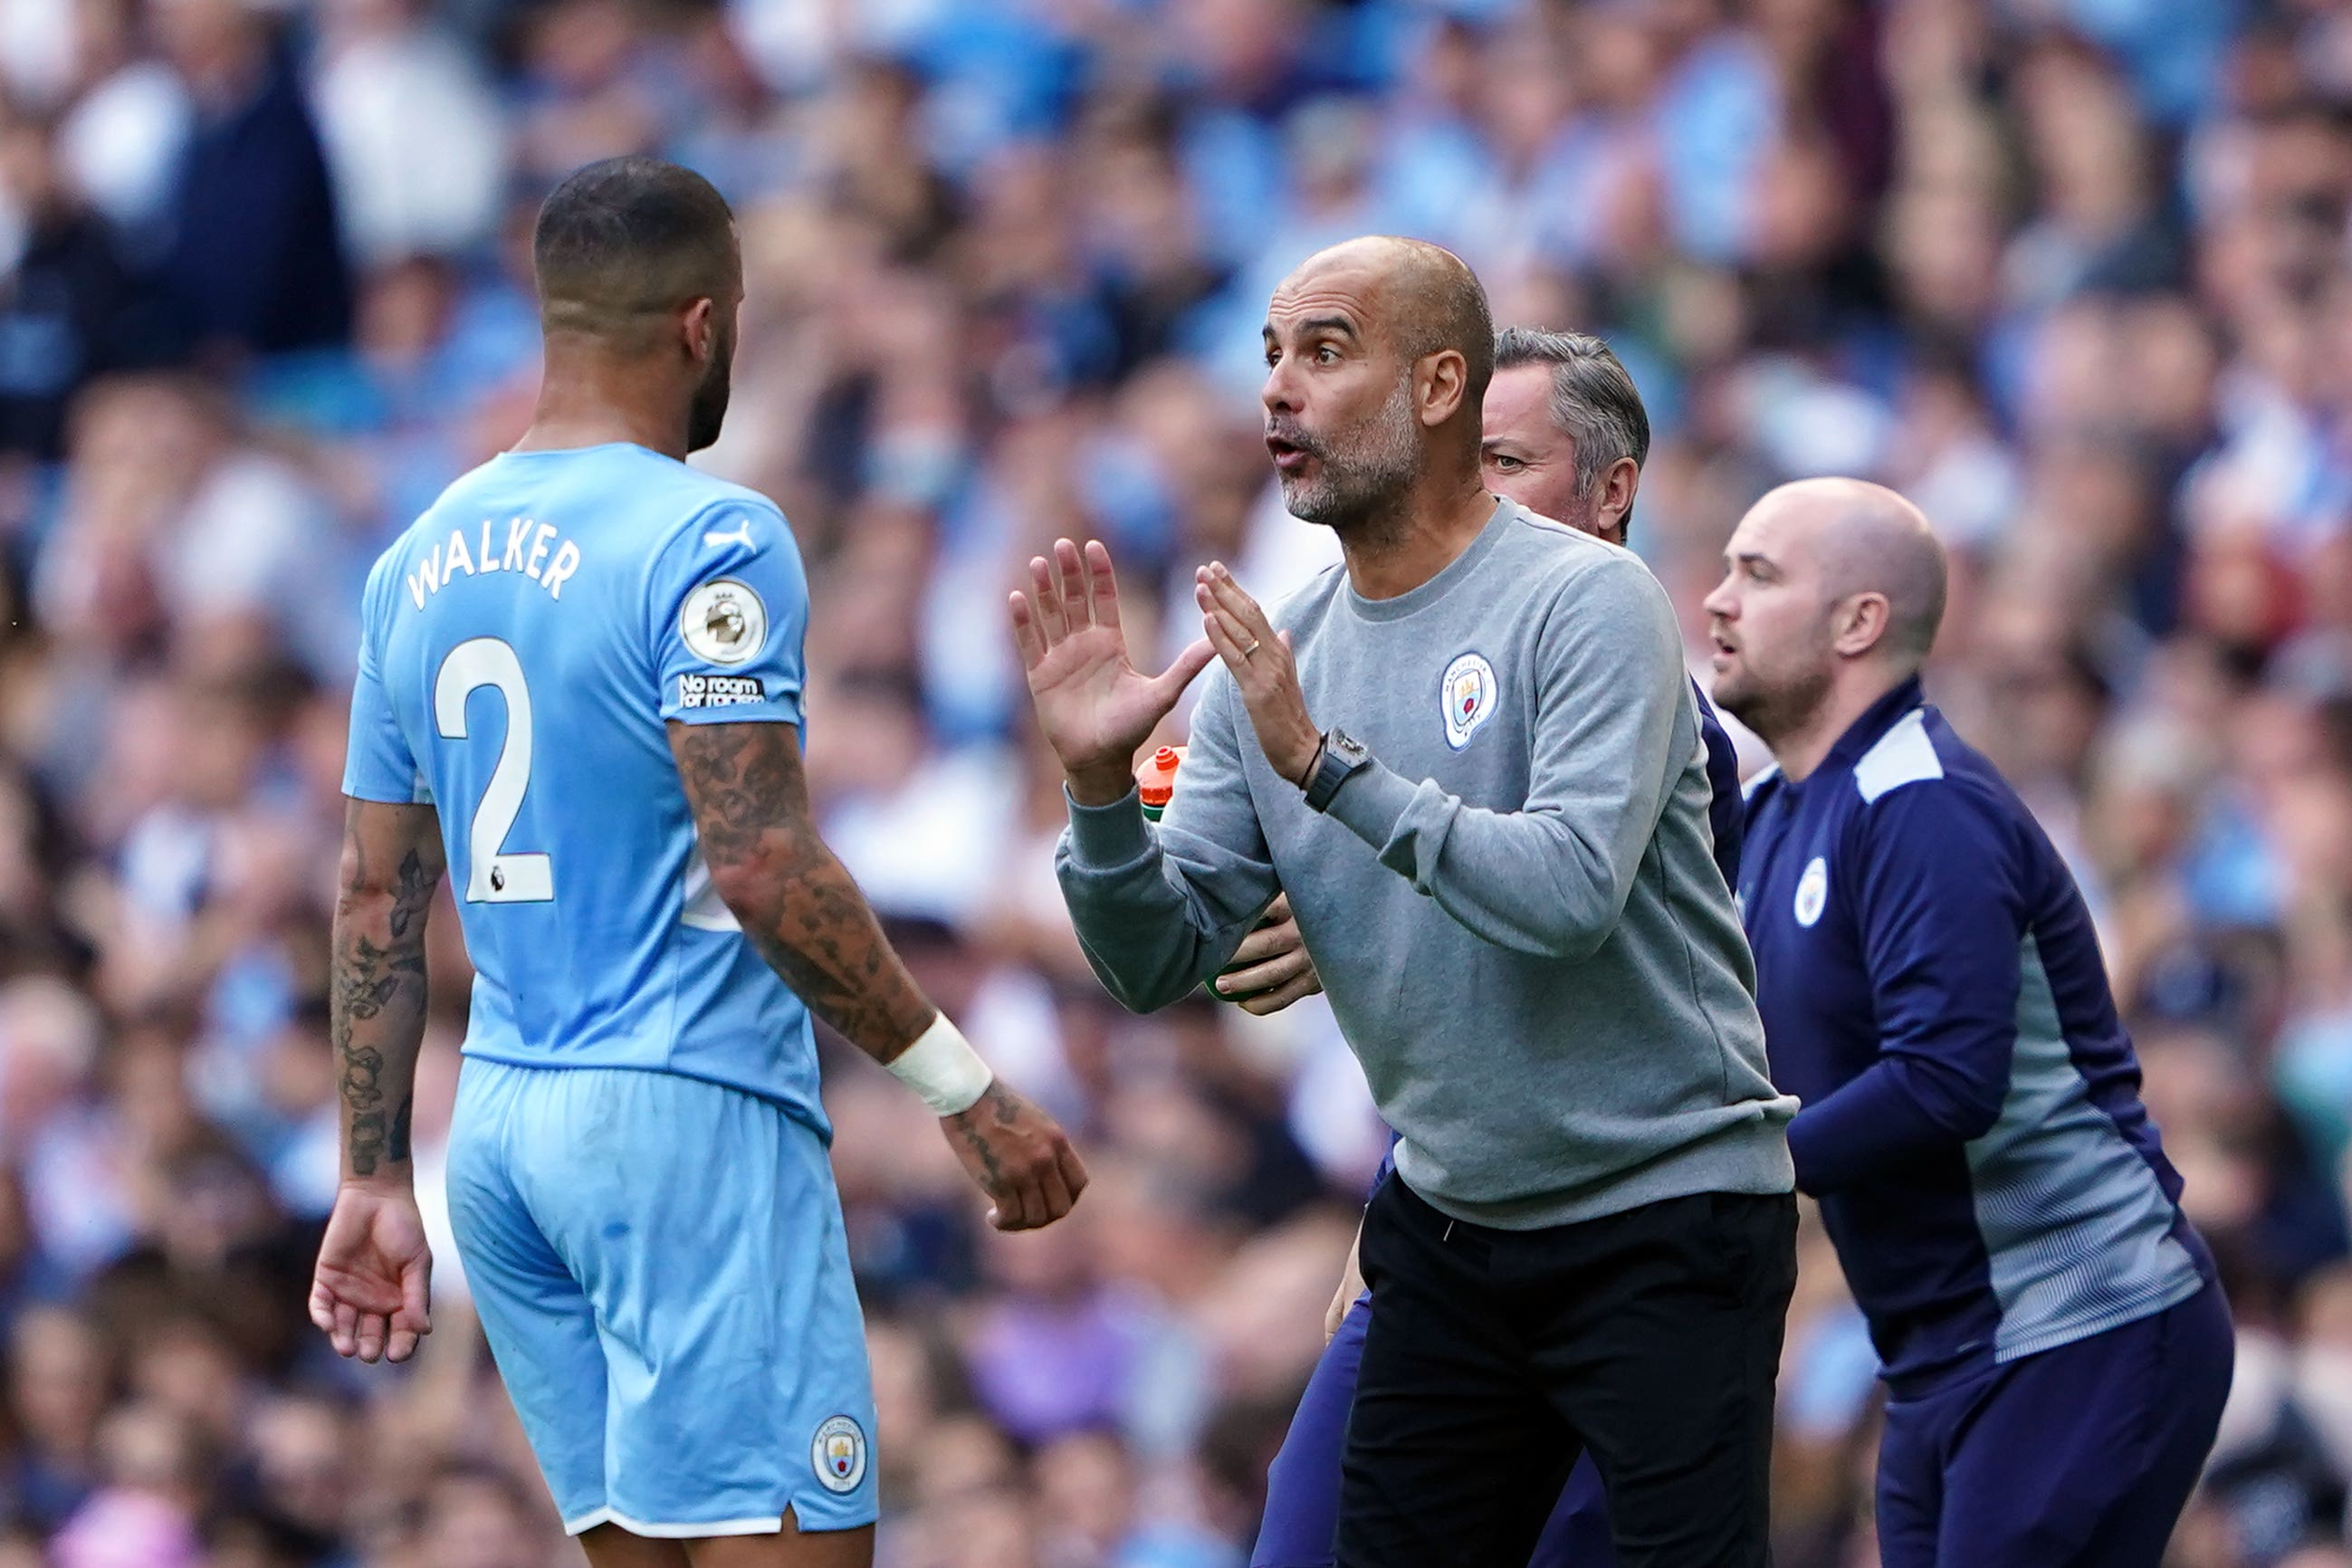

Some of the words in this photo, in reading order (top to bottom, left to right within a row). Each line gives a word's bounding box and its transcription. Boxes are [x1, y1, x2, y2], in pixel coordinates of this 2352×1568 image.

[407, 517, 580, 612] WALKER
[679, 674, 706, 693] No
[707, 675, 758, 694] room
[680, 690, 704, 708] for
[434, 636, 554, 903] 2
